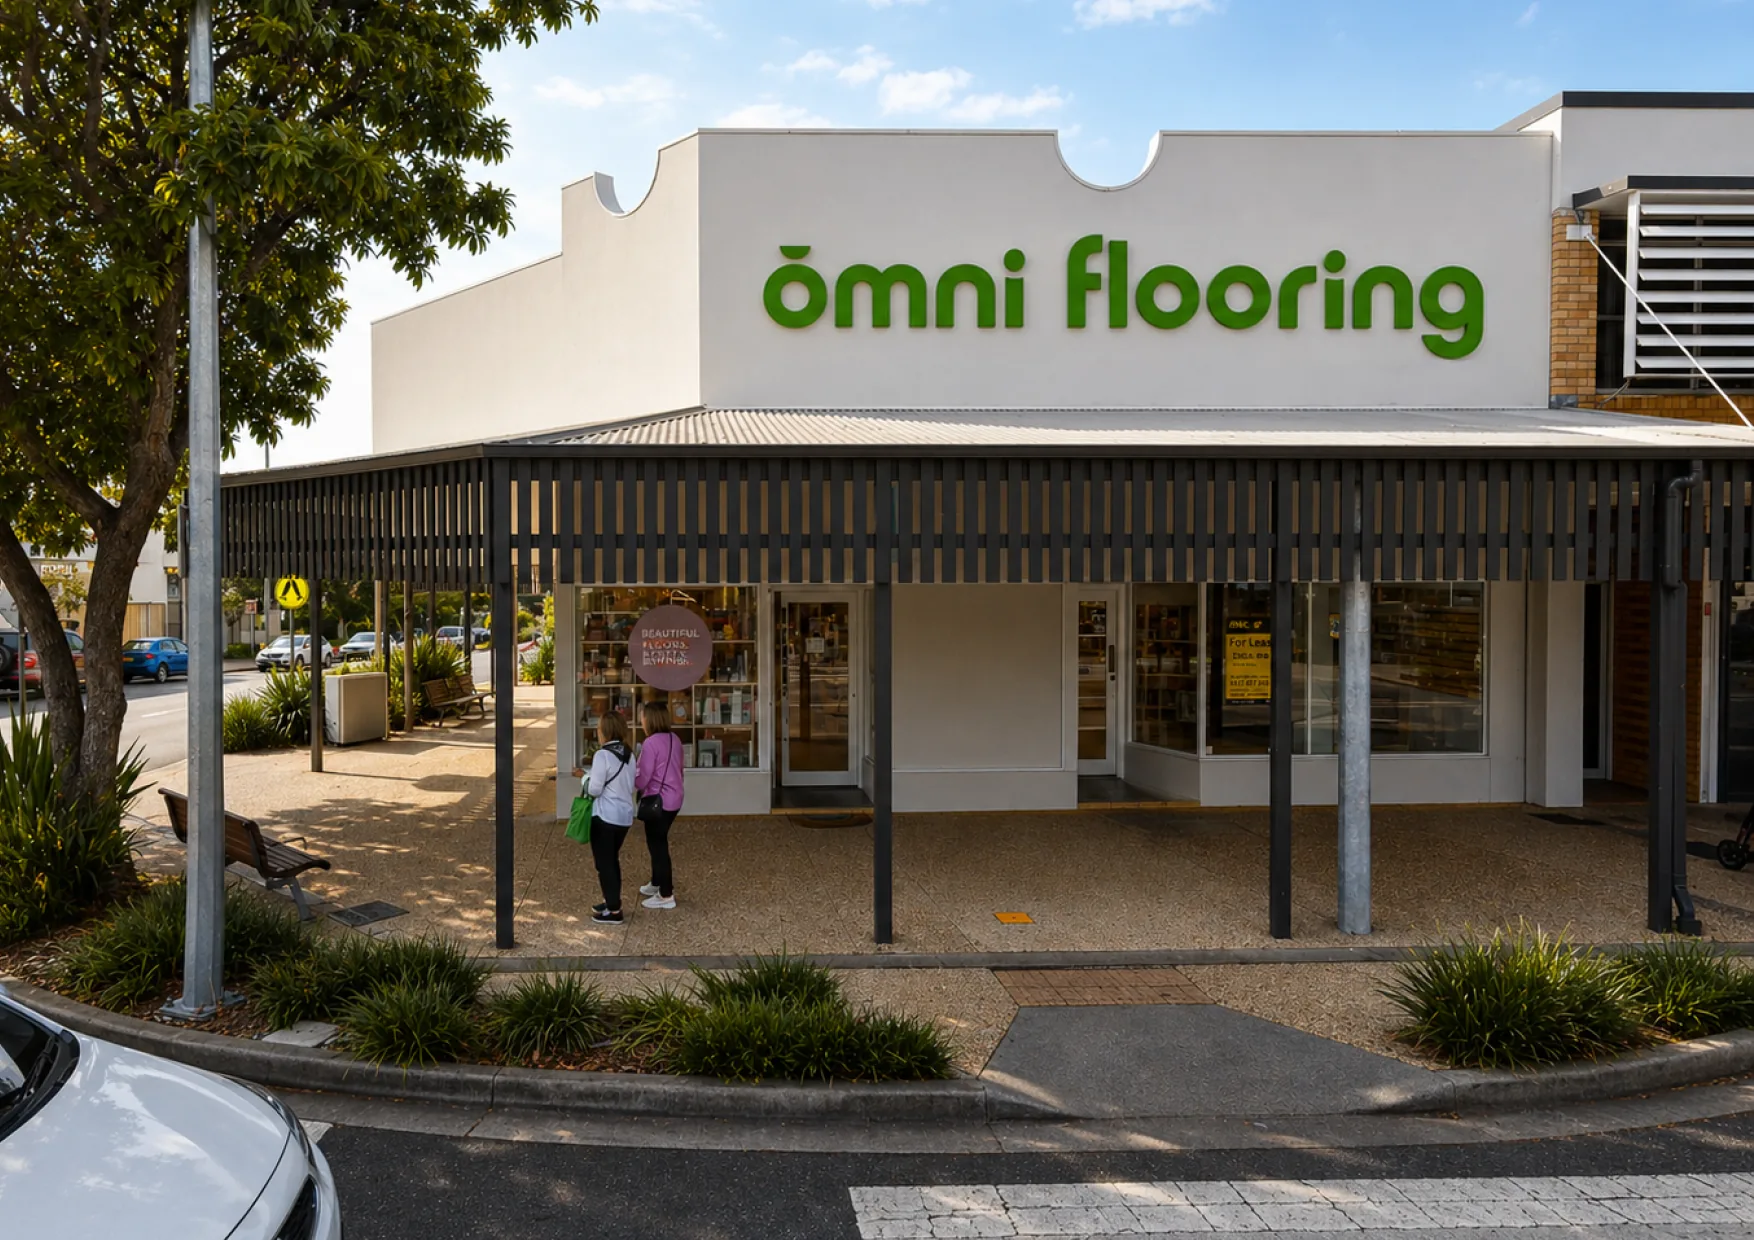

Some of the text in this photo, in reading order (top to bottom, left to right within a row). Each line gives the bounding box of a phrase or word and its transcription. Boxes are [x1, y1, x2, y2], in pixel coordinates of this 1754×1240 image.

[1068, 235, 1484, 358] flooring
[642, 629, 700, 638] BEAUTIFUL
[1230, 637, 1272, 647] For Leas
